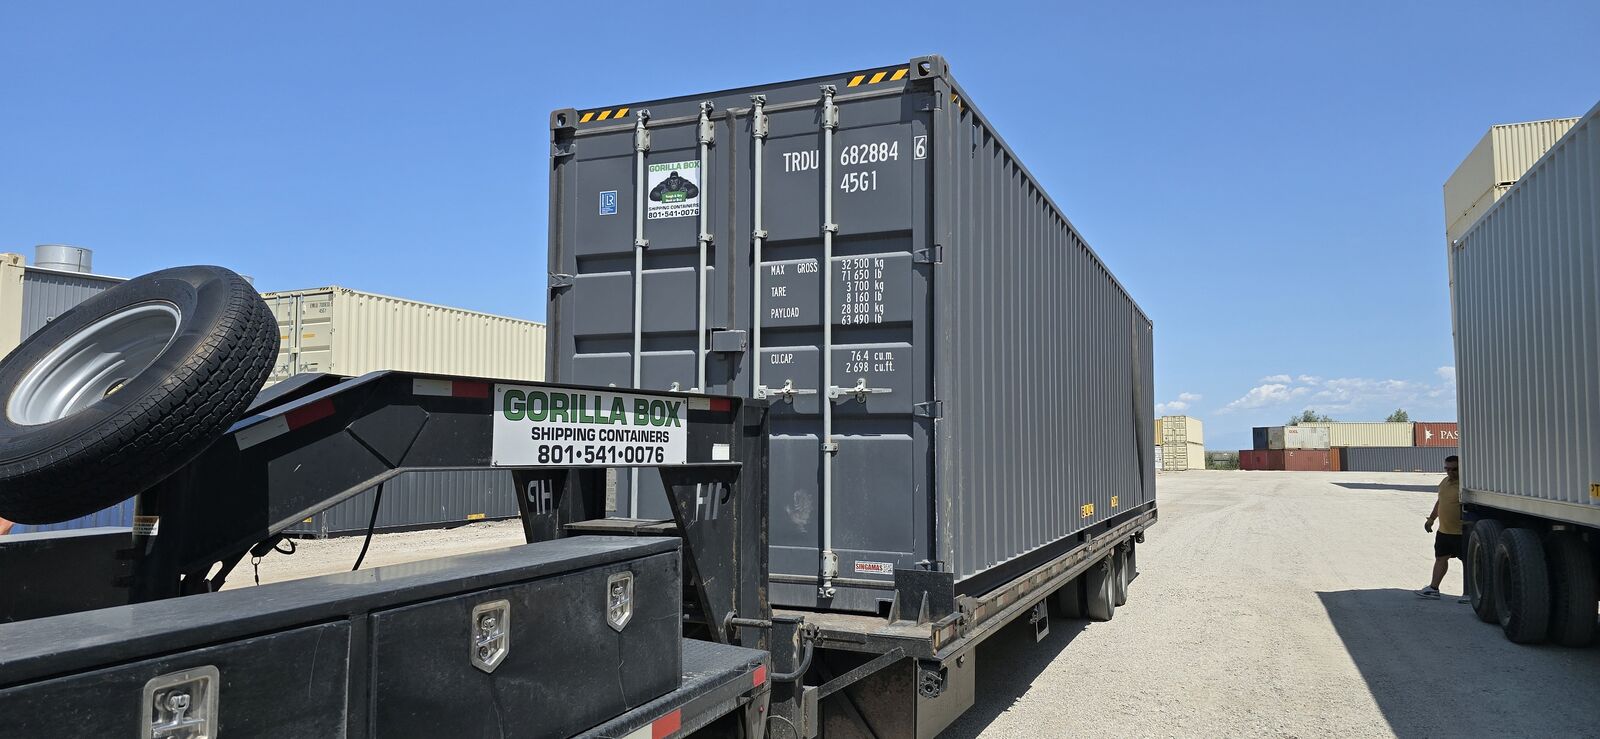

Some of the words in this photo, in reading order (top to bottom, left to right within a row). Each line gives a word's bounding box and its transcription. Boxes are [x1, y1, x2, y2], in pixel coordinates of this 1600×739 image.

[783, 150, 820, 172] TRDU
[840, 141, 898, 166] 682884
[915, 136, 926, 159] 6
[650, 163, 681, 172] GORILLA
[840, 171, 876, 193] 45G1
[771, 265, 784, 275] MAX
[797, 262, 818, 274] GROSS
[841, 259, 851, 270] 32
[854, 258, 870, 269] 500
[874, 258, 884, 270] kg
[842, 271, 851, 281] 71
[854, 270, 870, 280] 650
[874, 269, 882, 278] lb
[771, 287, 786, 297] TARE
[846, 282, 851, 292] 3
[854, 281, 870, 291] 700
[874, 280, 884, 292] kg
[846, 293, 851, 303] 8
[855, 292, 870, 302] 160
[874, 292, 882, 301] lb
[771, 307, 799, 318] PAYLOAD
[841, 304, 851, 314] 28
[854, 303, 870, 314] 800
[874, 303, 884, 314] kg
[841, 315, 851, 325] 63
[854, 314, 870, 324] 490
[874, 314, 882, 323] lb
[771, 354, 794, 364] CU.CAP.
[851, 351, 869, 361] 76.4
[874, 351, 894, 361] cu.m.
[846, 363, 851, 373] 2
[853, 362, 869, 372] 698
[874, 362, 895, 372] cu.ft.
[503, 390, 627, 425] GORILLA
[634, 399, 681, 428] BOX
[531, 427, 596, 442] SHIPPING
[599, 429, 669, 443] CONTAINERS
